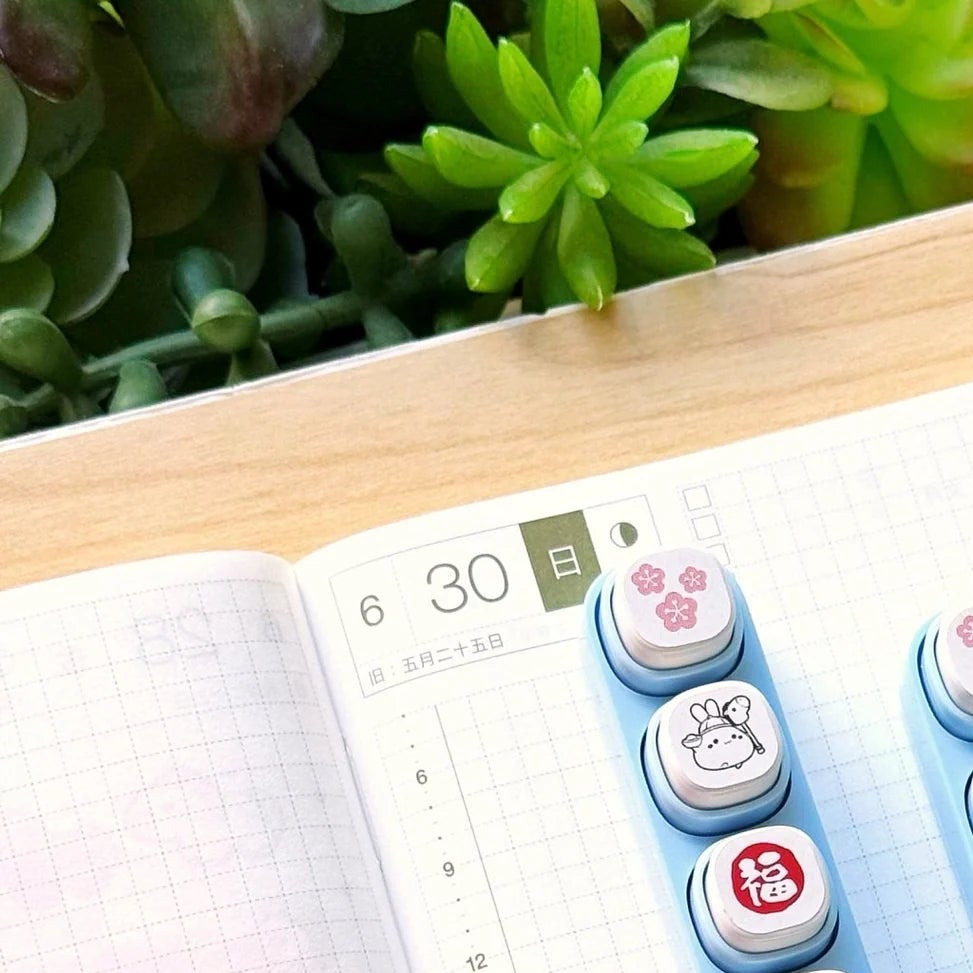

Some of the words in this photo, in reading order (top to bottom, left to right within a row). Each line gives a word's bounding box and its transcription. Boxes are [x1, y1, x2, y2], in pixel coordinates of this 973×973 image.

[548, 545, 581, 579] 日
[360, 595, 384, 626] 6
[427, 553, 509, 613] 30
[416, 769, 428, 785] 6
[442, 860, 455, 878] 9
[465, 952, 488, 973] 12
